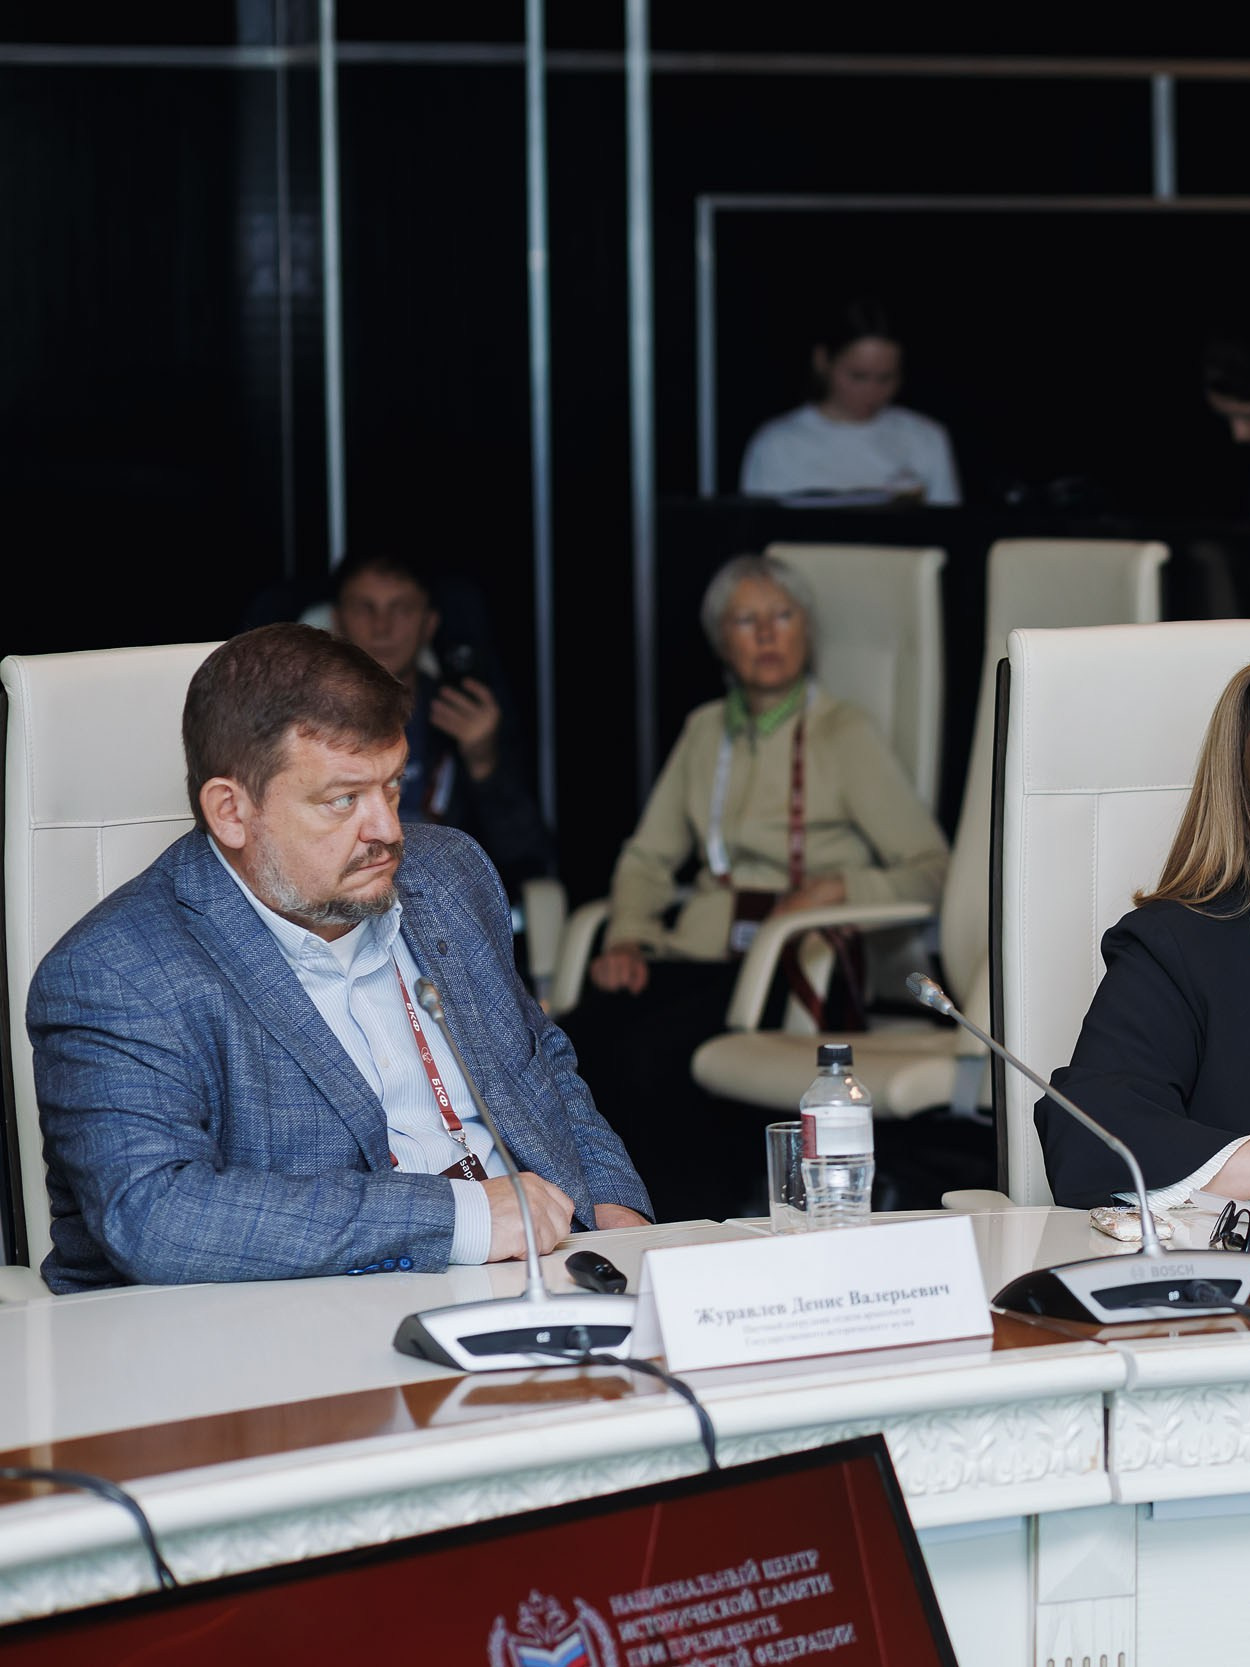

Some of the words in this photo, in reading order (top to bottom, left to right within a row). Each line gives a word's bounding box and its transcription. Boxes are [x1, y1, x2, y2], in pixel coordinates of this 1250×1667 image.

[406, 1002, 420, 1032] БКФ
[431, 1078, 449, 1107] БКФ
[1151, 1265, 1194, 1278] BOSCH
[694, 1302, 787, 1325] Журавлев
[792, 1296, 844, 1315] Денис
[849, 1283, 950, 1306] Валерьевич
[609, 1559, 761, 1617] НАЦИОНАЛЬНЫЙ
[762, 1549, 819, 1582] ЦЕНТР
[617, 1589, 757, 1643] ИСТОРИЧЕСКОЙ
[758, 1573, 834, 1609] ПАМЯТИ
[667, 1614, 783, 1660] ПРЕЗИДЕНТЕ
